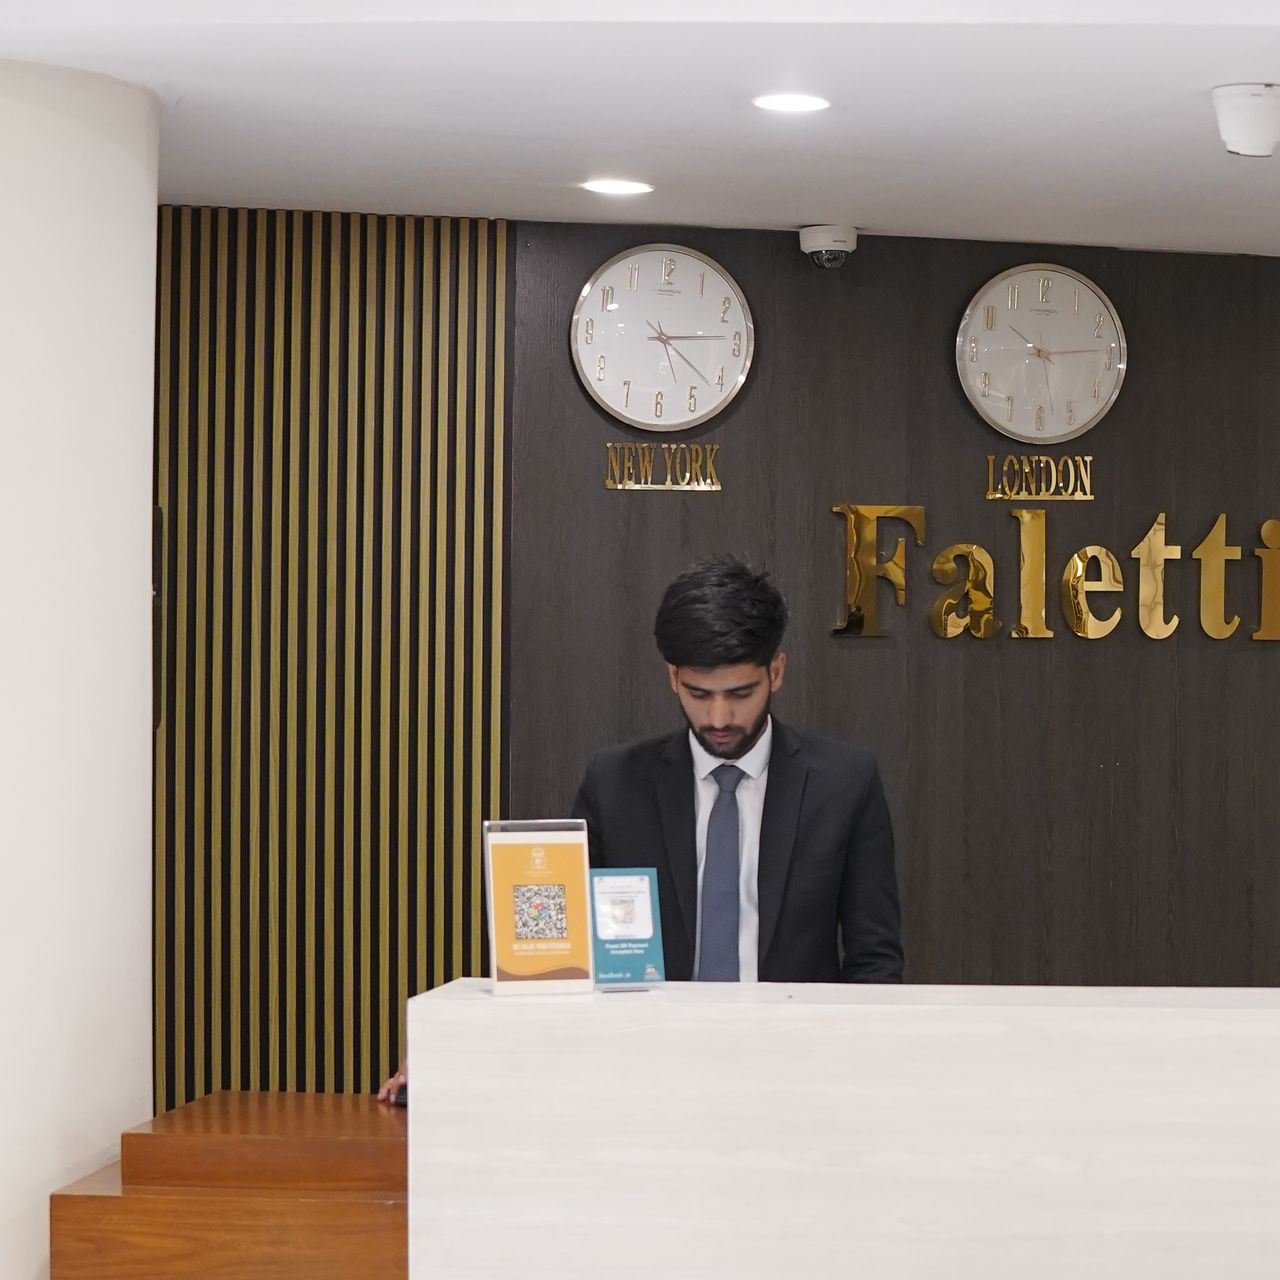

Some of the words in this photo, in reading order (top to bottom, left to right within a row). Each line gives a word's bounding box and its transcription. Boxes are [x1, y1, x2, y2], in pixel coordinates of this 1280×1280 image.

[628, 264, 639, 292] 11
[700, 271, 704, 297] 1
[1039, 278, 1052, 303] 12
[721, 297, 730, 323] 2
[1008, 285, 1018, 310] 11
[1074, 289, 1078, 314] 1
[1094, 313, 1104, 338] 2
[716, 366, 724, 392] 4
[624, 381, 630, 407] 7
[655, 391, 663, 417] 6
[689, 386, 697, 412] 5
[605, 442, 656, 489] NEW
[661, 443, 720, 490] YORK
[986, 455, 1094, 499] LONDON
